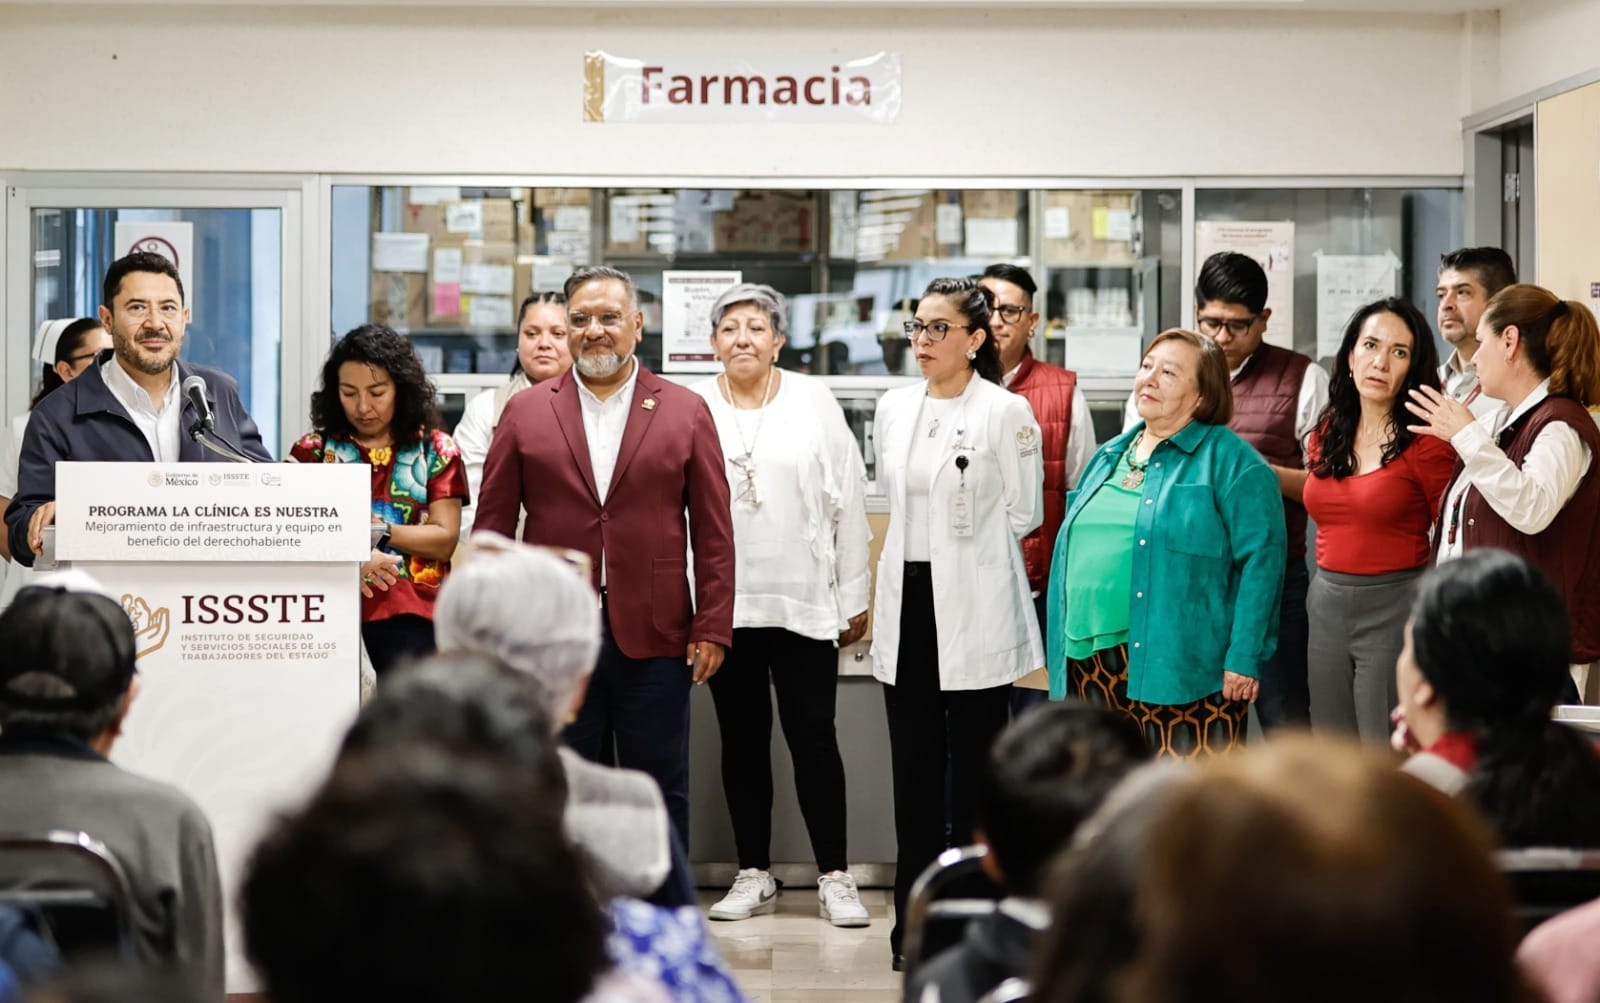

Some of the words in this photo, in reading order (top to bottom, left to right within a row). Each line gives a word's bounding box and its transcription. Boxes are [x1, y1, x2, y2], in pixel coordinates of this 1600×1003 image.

[641, 65, 871, 106] Farmacia
[165, 477, 199, 487] México
[88, 505, 168, 518] PROGRAMA
[172, 505, 190, 518] LA
[194, 503, 250, 518] CLÍNICA
[254, 506, 271, 518] ES
[276, 506, 339, 518] NUESTRA
[85, 521, 167, 534] Mejoramiento
[169, 521, 184, 533] de
[187, 521, 273, 533] infraestructura
[275, 524, 283, 535] y
[285, 521, 325, 535] equipo
[327, 523, 342, 533] en
[127, 535, 180, 547] beneficio
[183, 535, 201, 547] del
[203, 535, 302, 547] derechohabiente
[181, 594, 325, 625] ISSSTE
[180, 633, 235, 642] INSTITUTO
[239, 633, 251, 641] DE
[255, 632, 314, 641] SEGURIDAD
[180, 643, 187, 651] Y
[190, 643, 244, 651] SERVICIOS
[248, 642, 298, 650] SOCIALES
[300, 642, 314, 650] DE
[318, 641, 337, 650] LOS
[181, 652, 263, 661] TRABAJADORES
[266, 652, 285, 660] DEL
[288, 651, 329, 660] ESTADO
